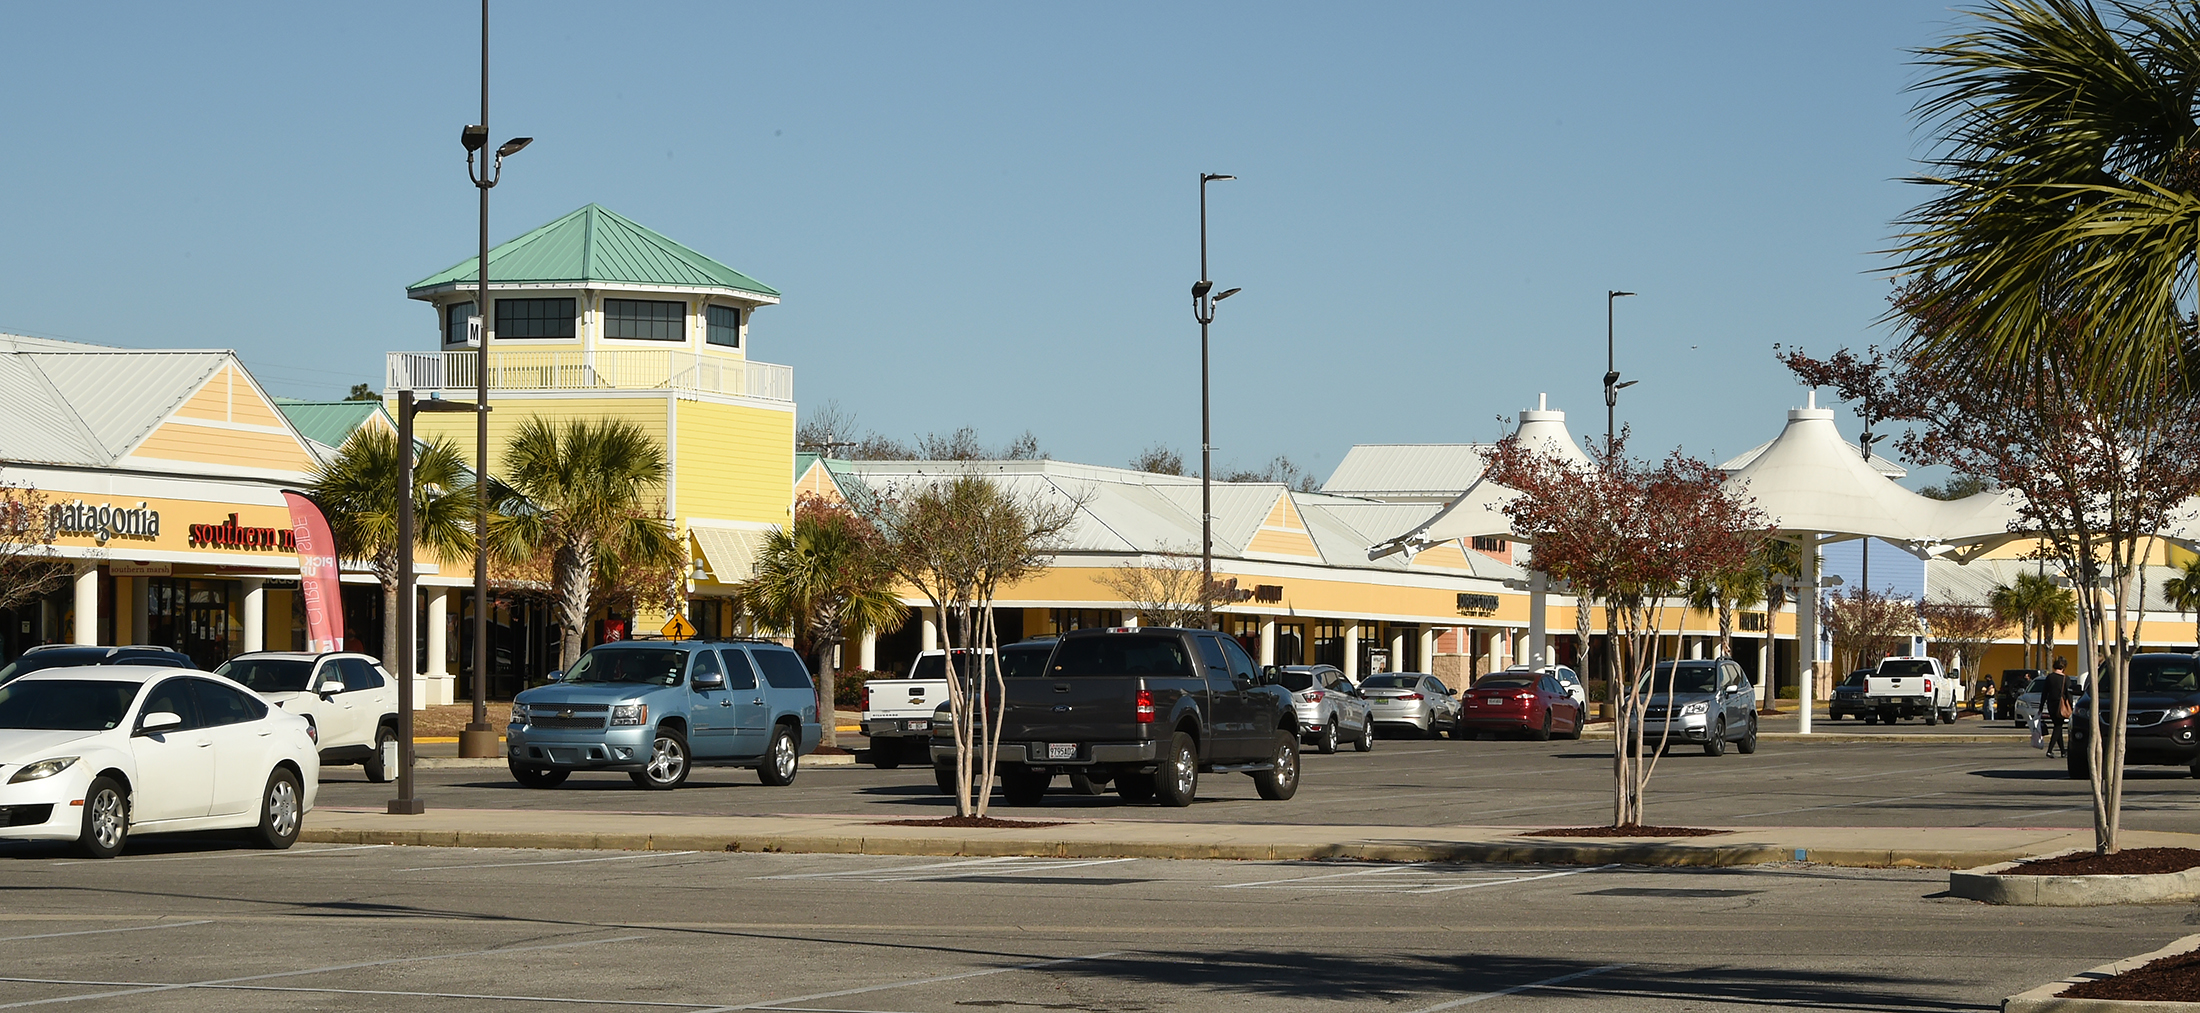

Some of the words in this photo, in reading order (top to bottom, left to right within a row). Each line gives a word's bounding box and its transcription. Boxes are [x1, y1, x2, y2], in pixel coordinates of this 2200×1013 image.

[470, 323, 479, 340] M
[50, 502, 160, 541] patagonia
[193, 512, 277, 547] southern
[111, 565, 144, 573] southern
